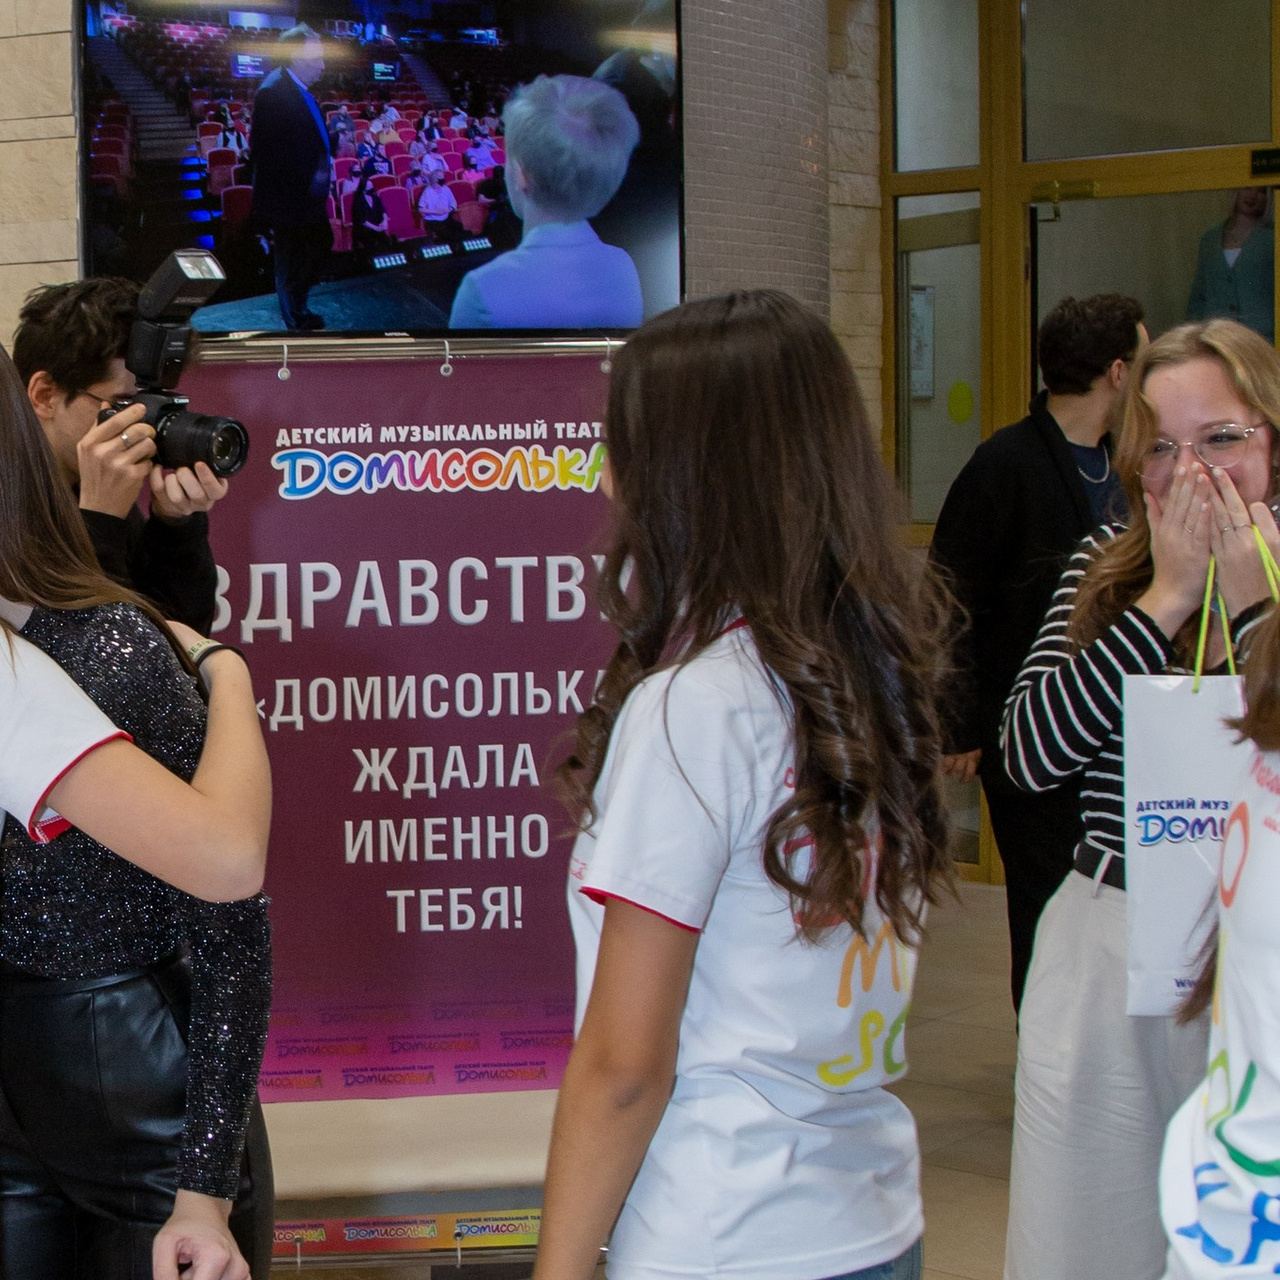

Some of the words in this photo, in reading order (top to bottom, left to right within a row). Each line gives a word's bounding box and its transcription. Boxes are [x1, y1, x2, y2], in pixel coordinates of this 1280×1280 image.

[276, 423, 373, 447] ДЕТСКИЙ
[379, 419, 548, 443] МУЗЫКАЛЬНЫЙ
[554, 421, 604, 439] ТЕАТ
[352, 743, 540, 799] ЖДАЛА
[1136, 797, 1196, 812] ДЕТСКИЙ
[1200, 801, 1229, 811] МУЗ
[344, 814, 550, 864] ИМЕННО
[386, 886, 524, 933] ТЕБЯ!
